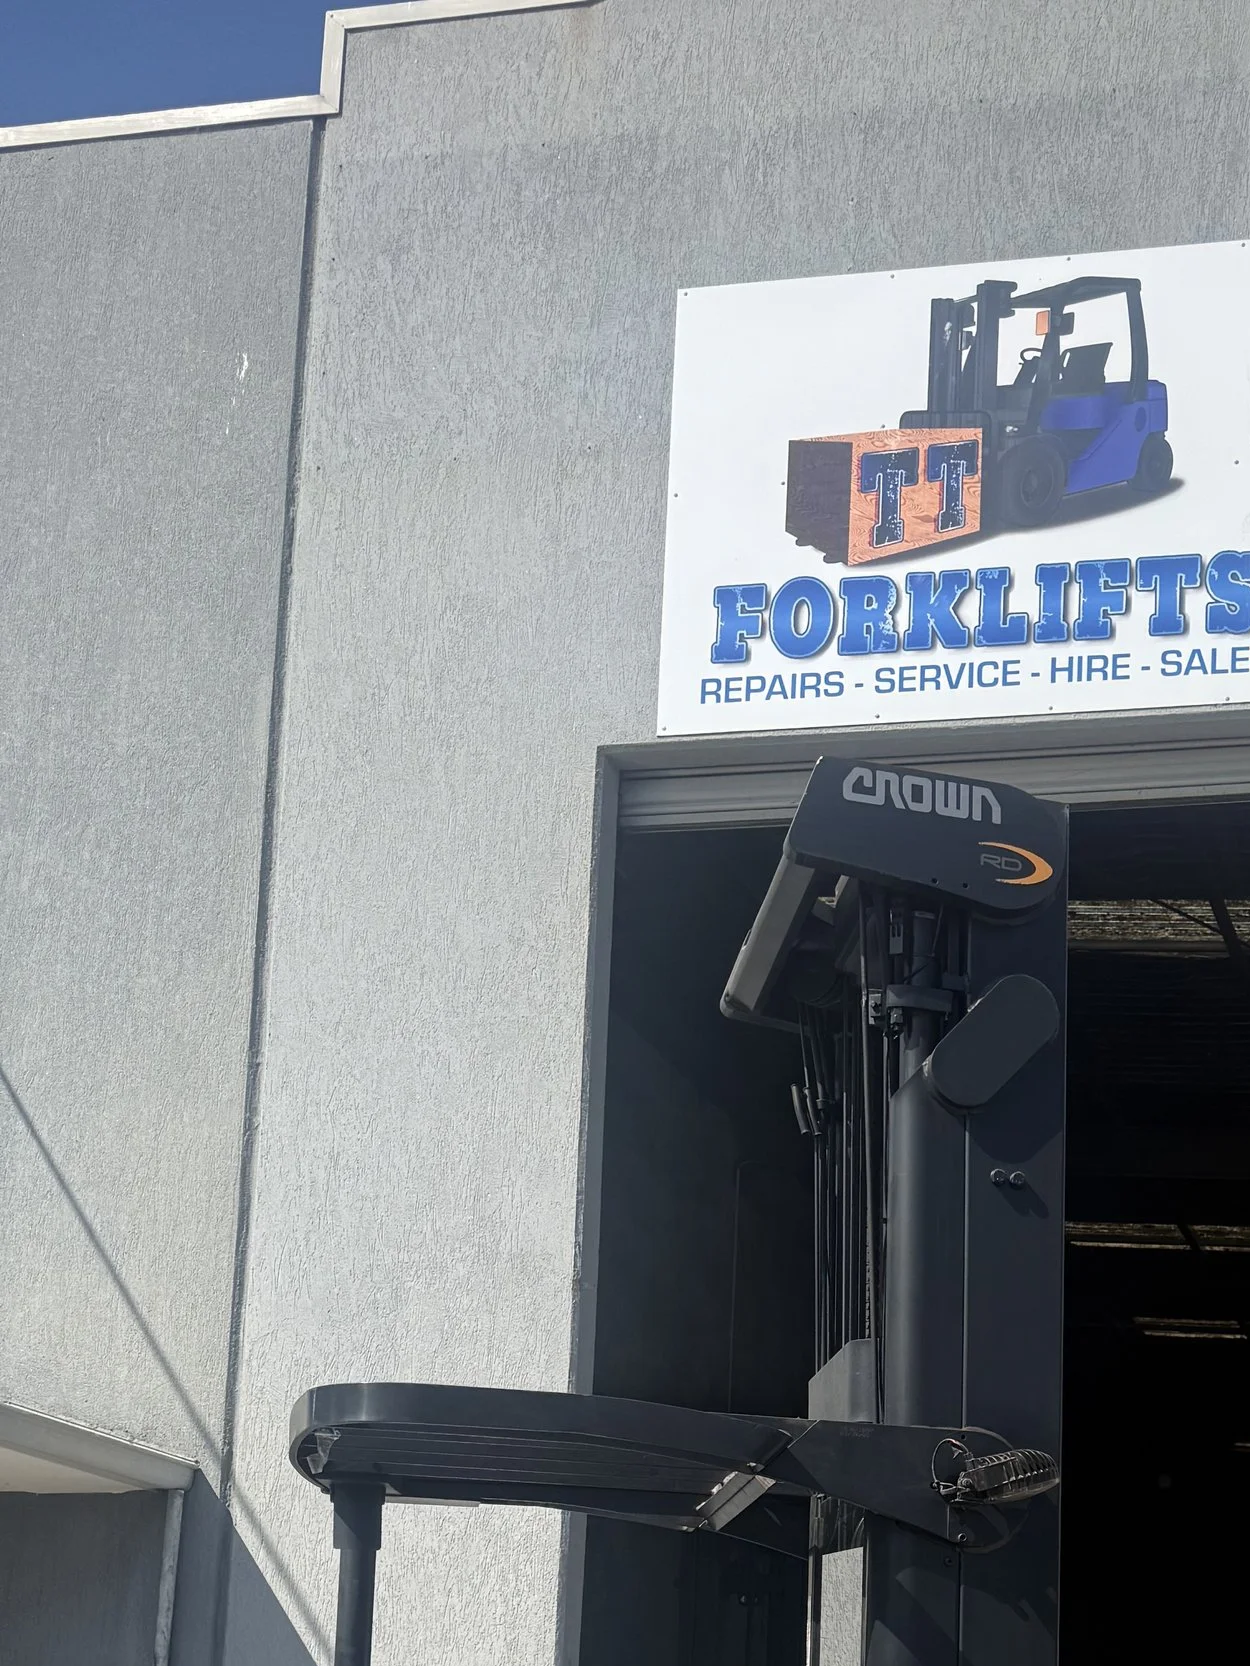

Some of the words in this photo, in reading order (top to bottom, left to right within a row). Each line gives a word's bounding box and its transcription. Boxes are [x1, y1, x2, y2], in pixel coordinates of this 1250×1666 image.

[860, 438, 979, 549] TT
[700, 670, 845, 705] REPAIRS
[874, 659, 1021, 694] SERVICE
[1050, 653, 1131, 684] HIRE
[842, 766, 1002, 825] CROWN
[980, 853, 1022, 872] RD
